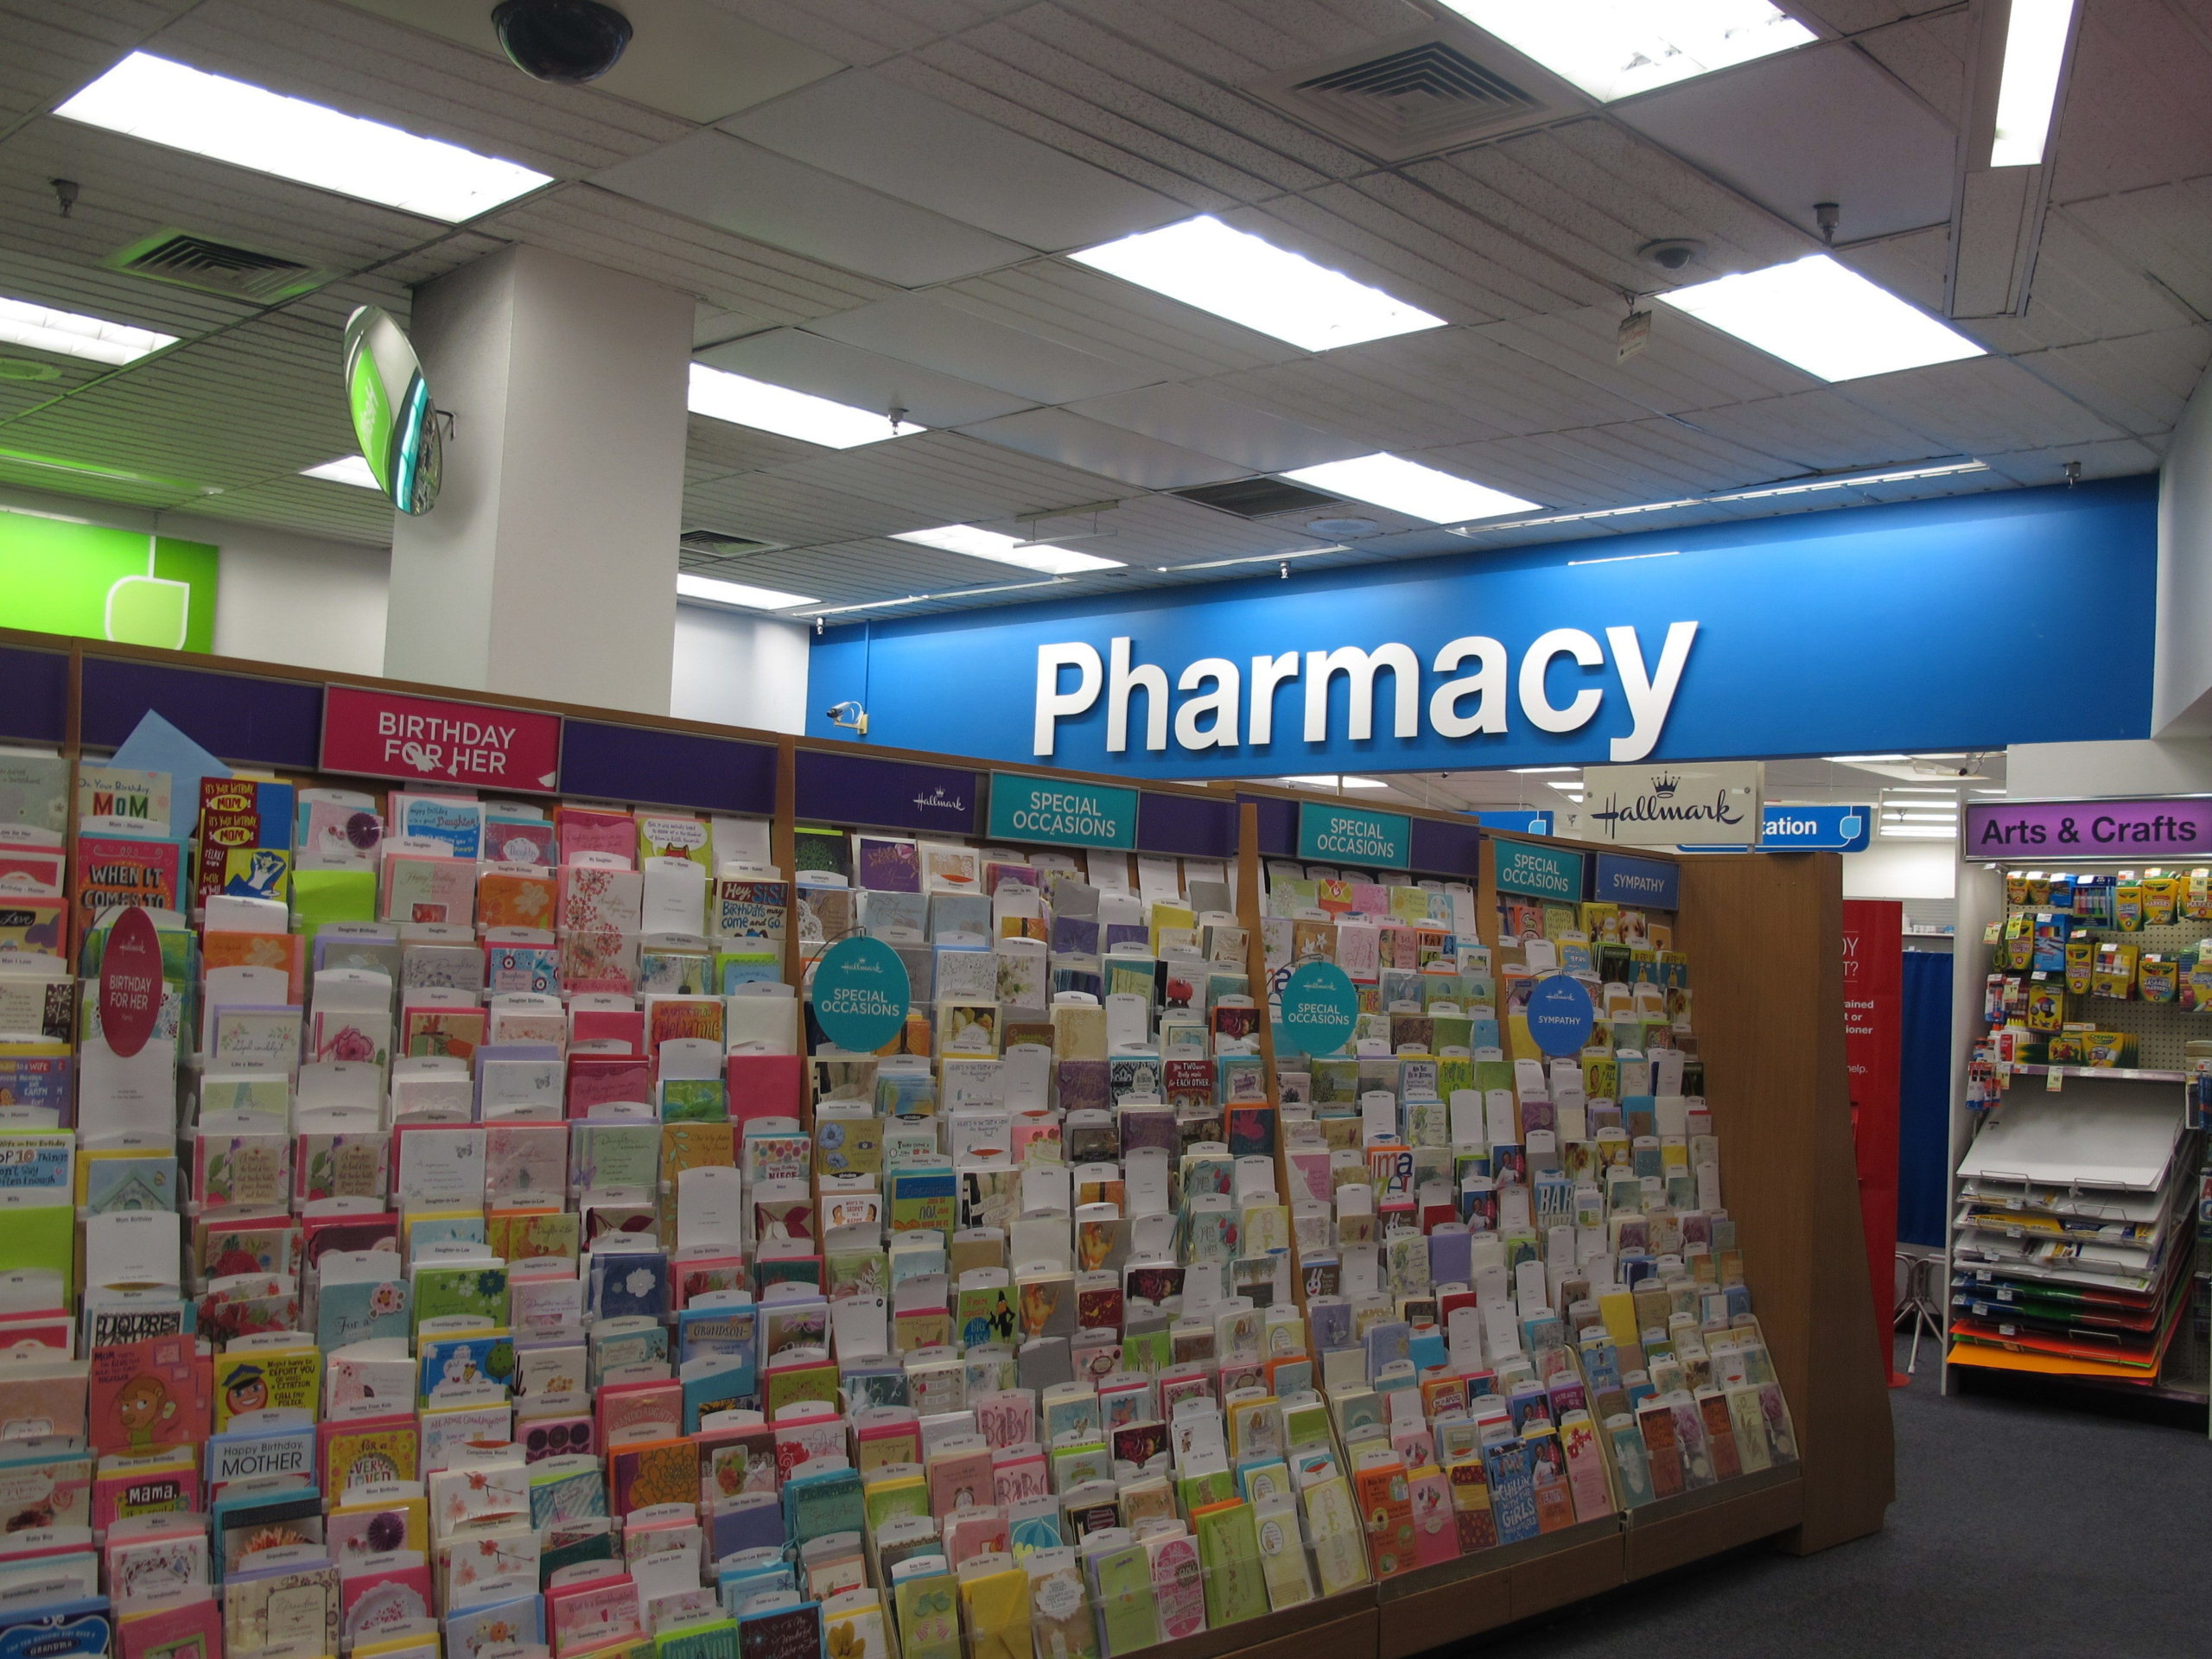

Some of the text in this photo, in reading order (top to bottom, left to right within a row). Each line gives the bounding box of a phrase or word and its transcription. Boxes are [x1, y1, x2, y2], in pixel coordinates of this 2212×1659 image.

[1033, 620, 1699, 762] Pharmacy
[378, 711, 516, 749] BIRTHDAY
[385, 740, 506, 775] FOR HER
[94, 779, 112, 791] Your
[913, 791, 966, 812] Hallmark
[1031, 791, 1102, 817] SPECIAL
[1591, 789, 1745, 839] Hallmark
[1013, 810, 1116, 838] OCCASIONS
[1331, 817, 1384, 839] SPECIAL
[1981, 815, 2196, 844] Arts & Crafts
[1318, 835, 1395, 858] OCCASIONS
[1514, 853, 1560, 875] SPECIAL
[90, 865, 163, 887] WHEN IT
[1503, 868, 1568, 892] OCCASIONS
[1613, 873, 1665, 893] SYMPATHY
[726, 883, 751, 899] Hey,
[145, 893, 166, 910] TO
[766, 908, 785, 918] may
[841, 963, 884, 975] Hallmark
[110, 975, 151, 994] BIRTHDAY
[1303, 982, 1337, 991] Hallmark
[110, 993, 149, 1010] FOR HER
[833, 988, 888, 1003] SPECIAL
[822, 1000, 899, 1017] OCCASIONS
[1298, 1002, 1340, 1015] SPECIAL
[1288, 1013, 1350, 1026] OCCASIONS
[1538, 1015, 1581, 1026] SYMPATHY
[1177, 1078, 1192, 1087] EACH
[38, 1152, 68, 1164] Things
[970, 1319, 986, 1332] BIG
[270, 1365, 315, 1377] REPORT YOU
[224, 1440, 303, 1458] Happy Birthday,
[222, 1452, 302, 1477] MOTHER
[354, 1460, 383, 1474] VERY
[130, 1481, 178, 1504] Mama,
